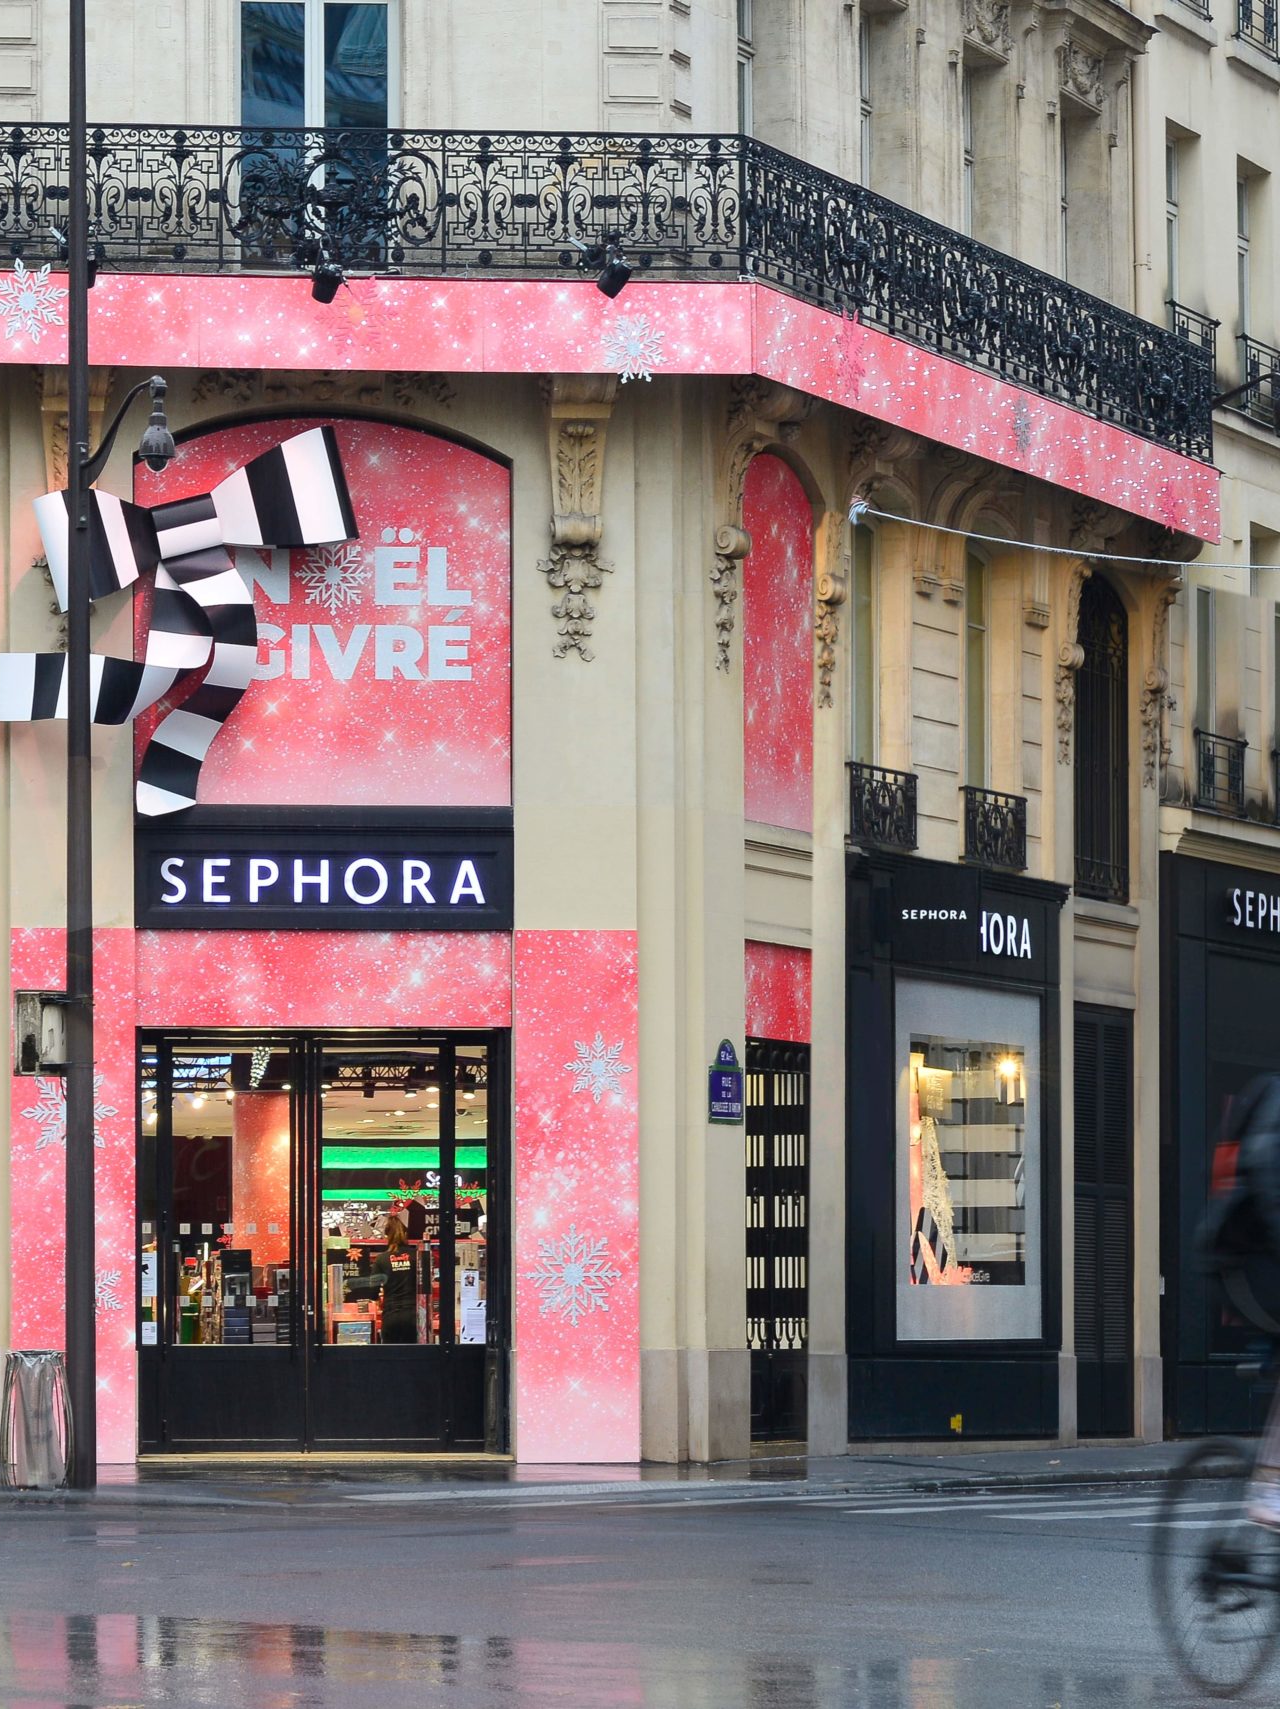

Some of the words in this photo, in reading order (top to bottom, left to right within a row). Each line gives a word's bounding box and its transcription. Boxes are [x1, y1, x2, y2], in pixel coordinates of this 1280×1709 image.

[234, 527, 472, 606] NËL
[253, 611, 472, 682] GIVRÉ
[160, 857, 486, 904] SEPHORA
[902, 909, 967, 920] SEPHORA
[980, 911, 1032, 959] HORA
[391, 1260, 411, 1268] TEAM
